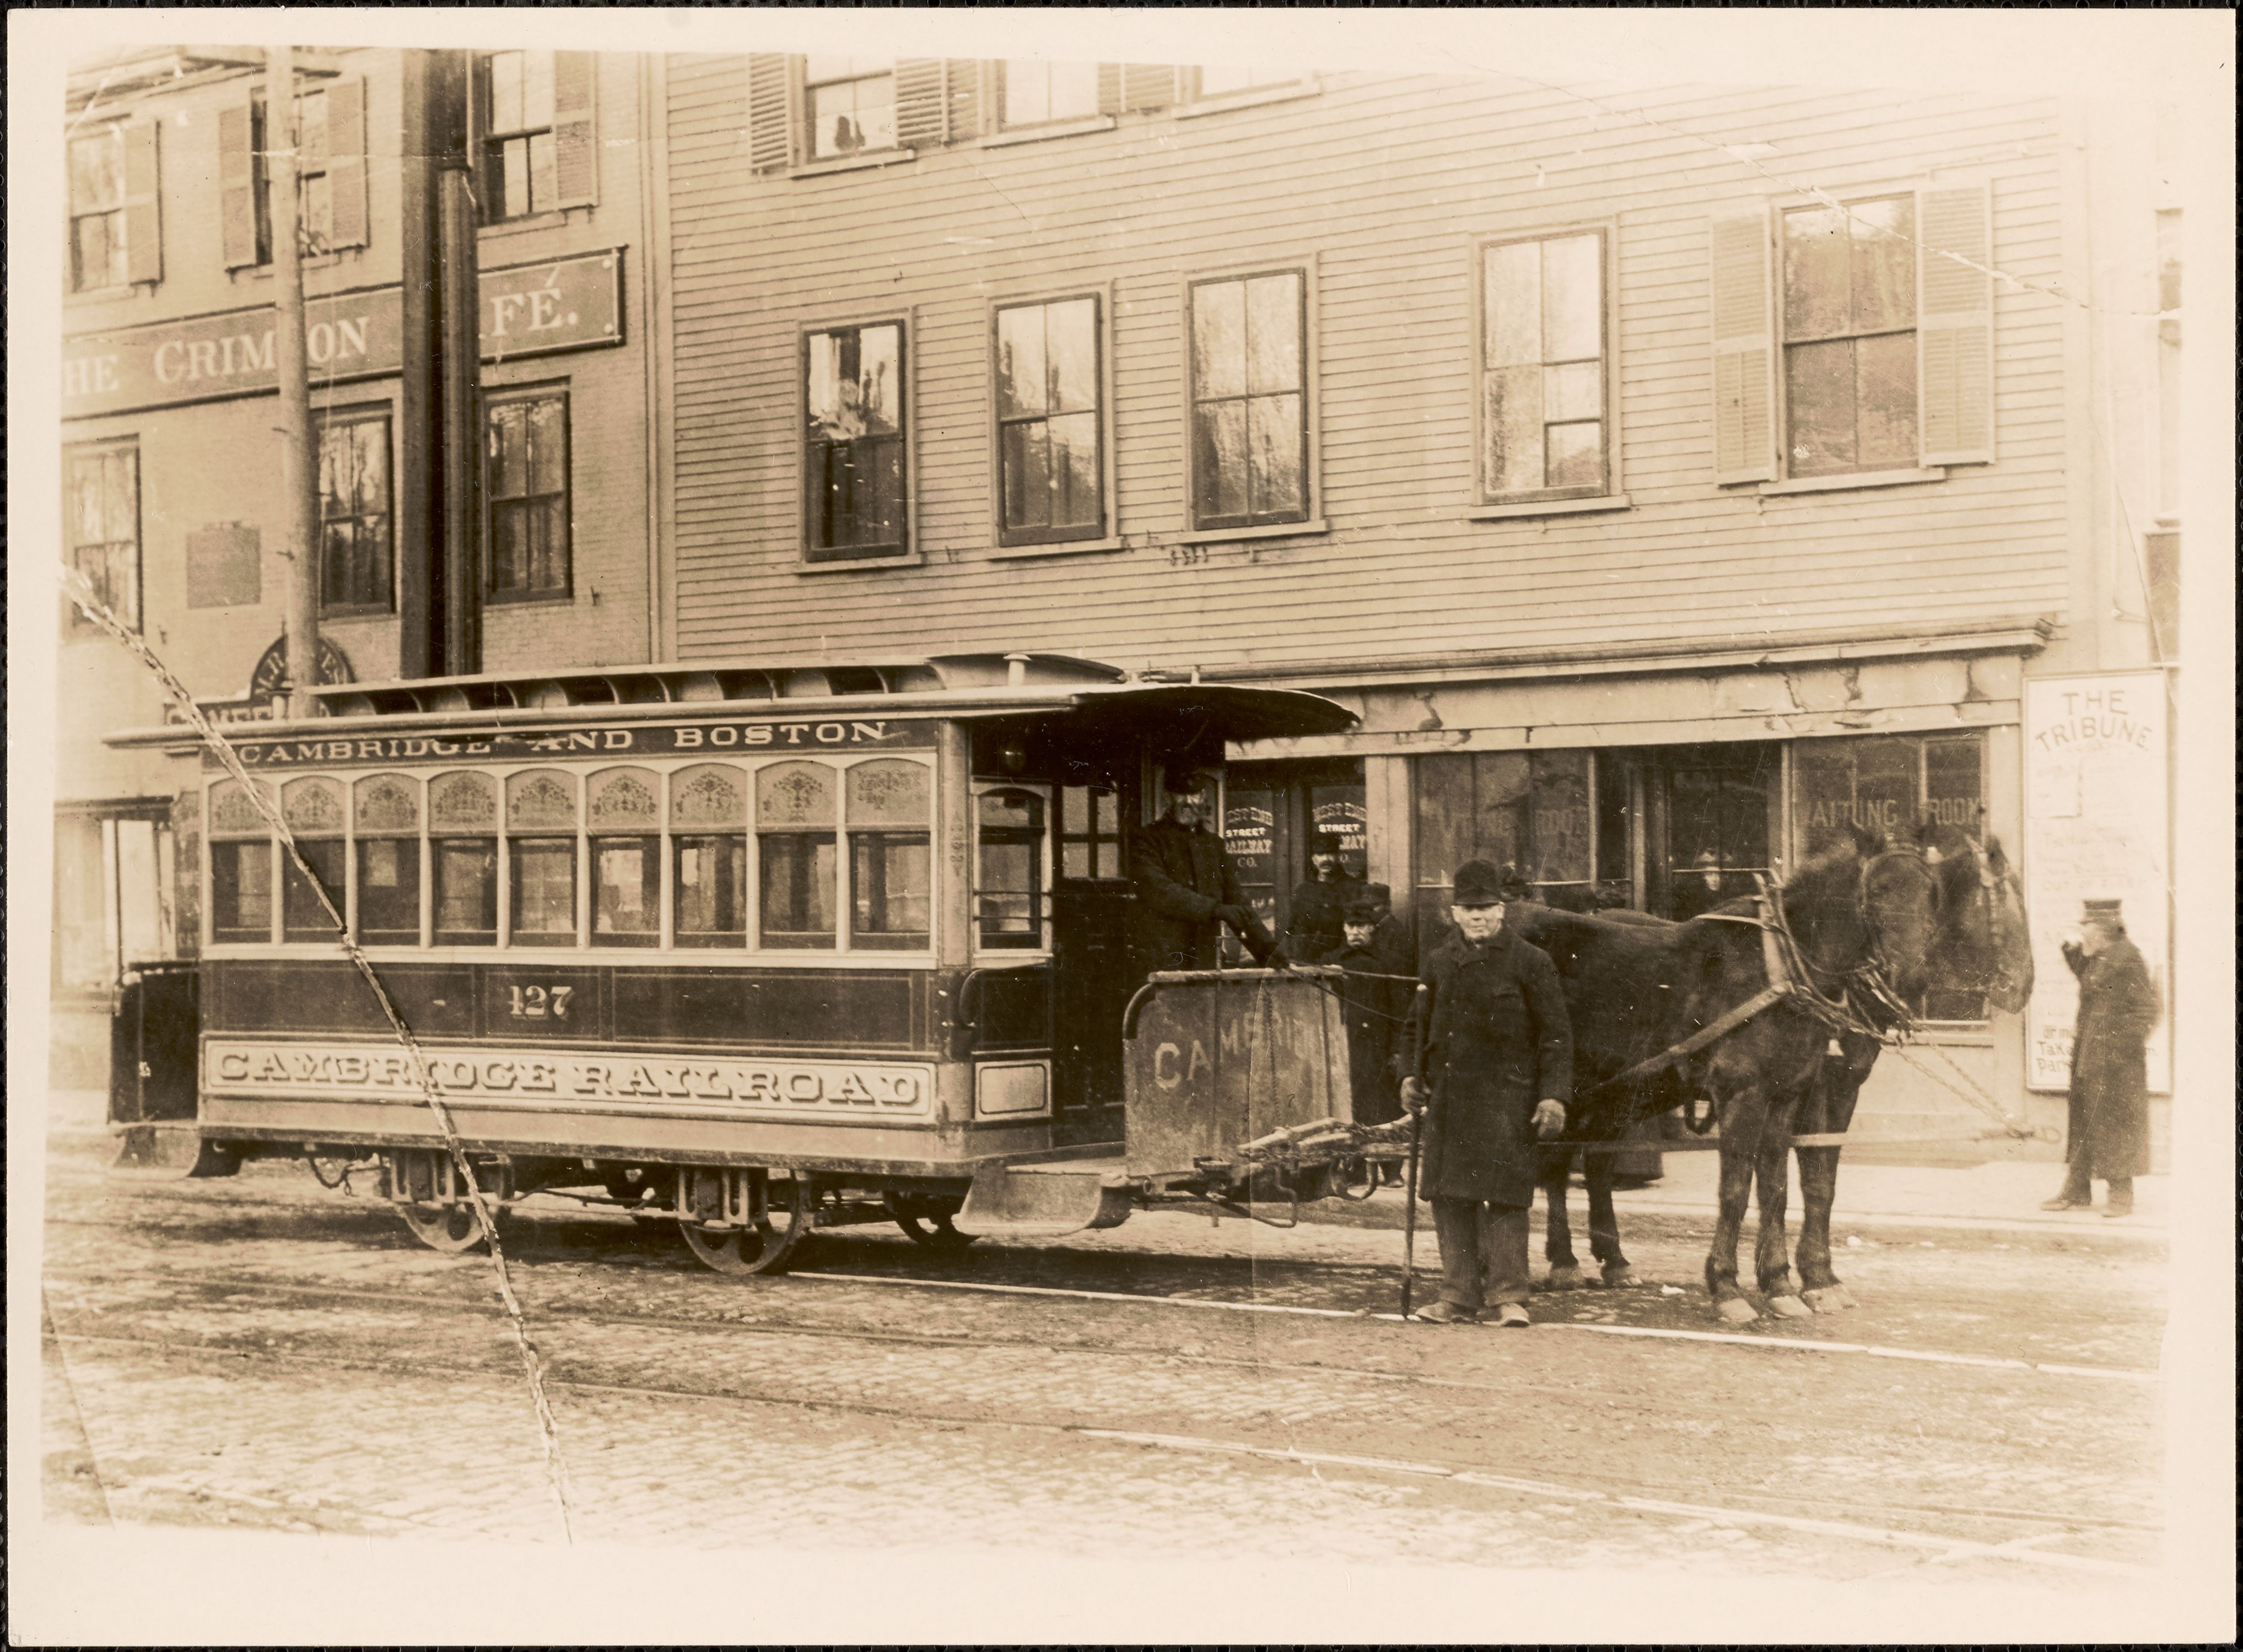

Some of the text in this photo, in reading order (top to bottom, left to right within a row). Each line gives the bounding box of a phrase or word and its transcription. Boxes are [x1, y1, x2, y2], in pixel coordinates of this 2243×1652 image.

[62, 266, 579, 396] HE CRIMON FÉ.
[2061, 689, 2129, 716] THE
[240, 721, 886, 763] CAMBRIDGE AND BOSTON
[2034, 716, 2153, 752] TRIBUNE
[1318, 824, 1361, 833] STREET
[1810, 799, 1899, 829] AITING
[1225, 827, 1266, 838] STREET
[1237, 857, 1258, 867] CO.
[508, 985, 574, 1019] 127
[219, 1051, 920, 1107] CAMBRIDGE RAILROAD
